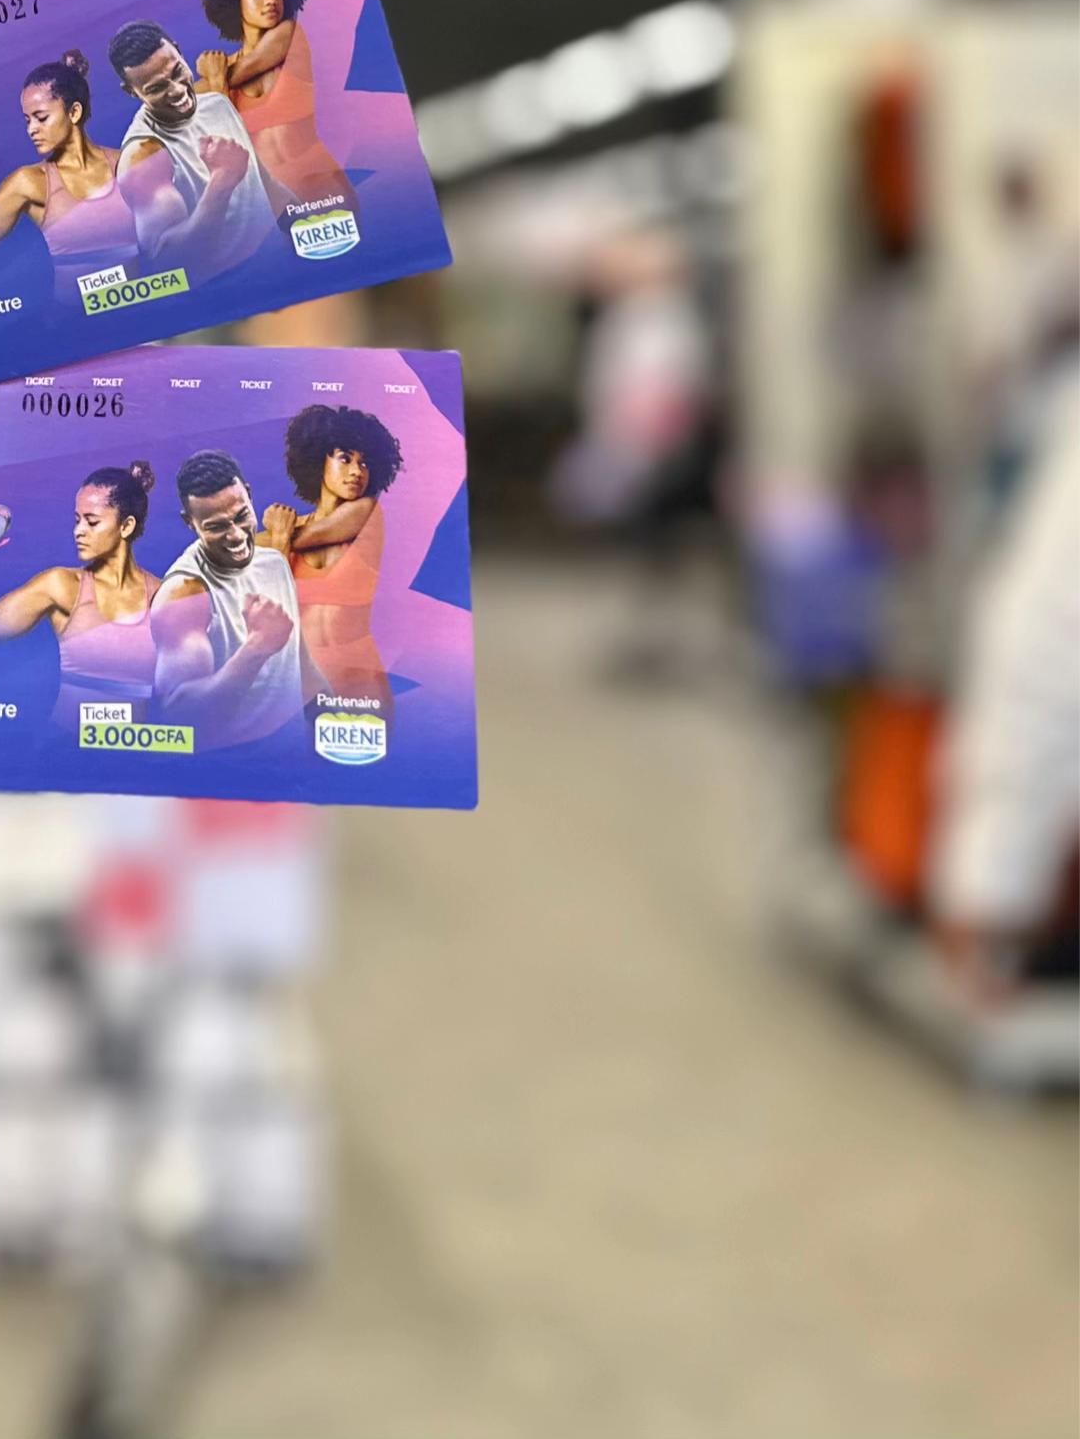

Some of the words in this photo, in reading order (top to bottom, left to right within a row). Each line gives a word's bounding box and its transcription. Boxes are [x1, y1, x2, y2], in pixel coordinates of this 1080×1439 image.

[286, 194, 345, 216] Partenaire
[295, 218, 356, 248] KIRÈNE
[80, 270, 122, 291] Ticket
[25, 377, 56, 387] TICKET
[92, 377, 124, 388] TICKET
[170, 378, 201, 389] TICKET
[240, 380, 272, 390] TICKET
[312, 381, 345, 392] TICKET
[384, 383, 417, 394] TICKET
[22, 392, 124, 417] 000026
[317, 693, 381, 709] Partenaire
[83, 706, 126, 720] Ticket
[319, 725, 384, 746] KIRÈNE
